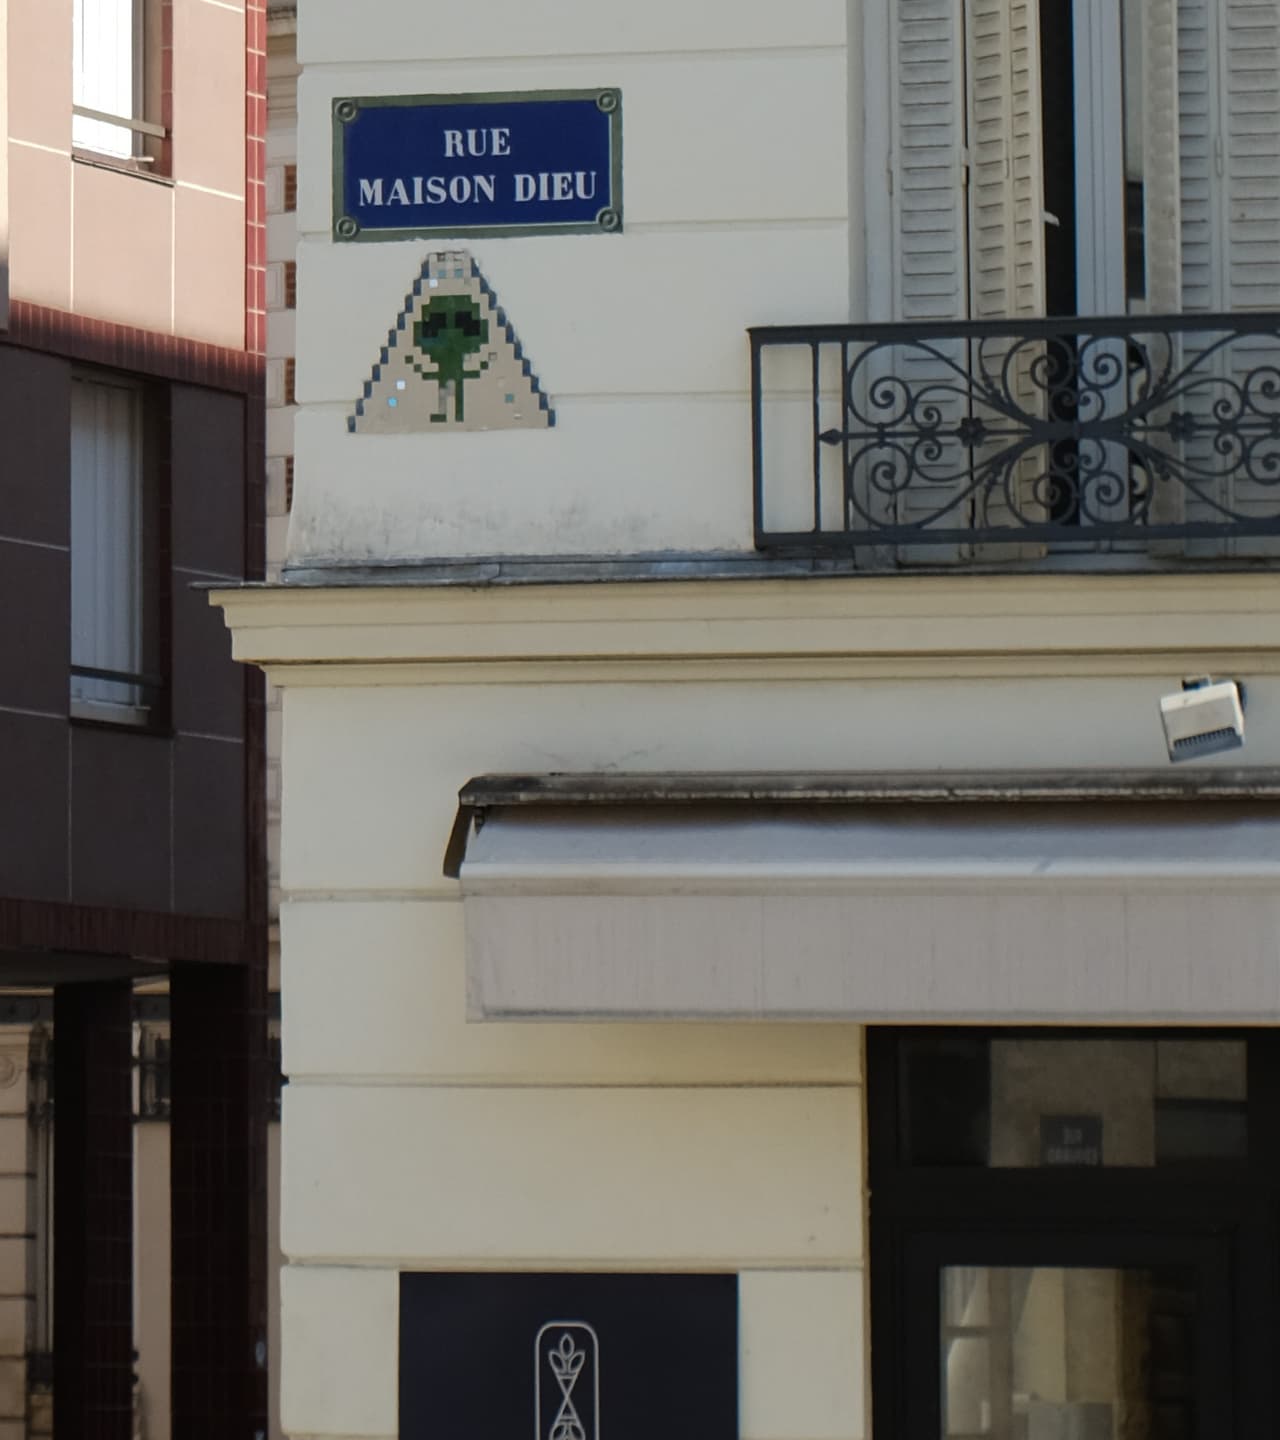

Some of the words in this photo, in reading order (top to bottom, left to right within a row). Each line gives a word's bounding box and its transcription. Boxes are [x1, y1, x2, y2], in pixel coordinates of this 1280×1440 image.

[444, 128, 511, 157] RUE
[358, 175, 496, 206] MAISON
[513, 171, 597, 203] DIEU
